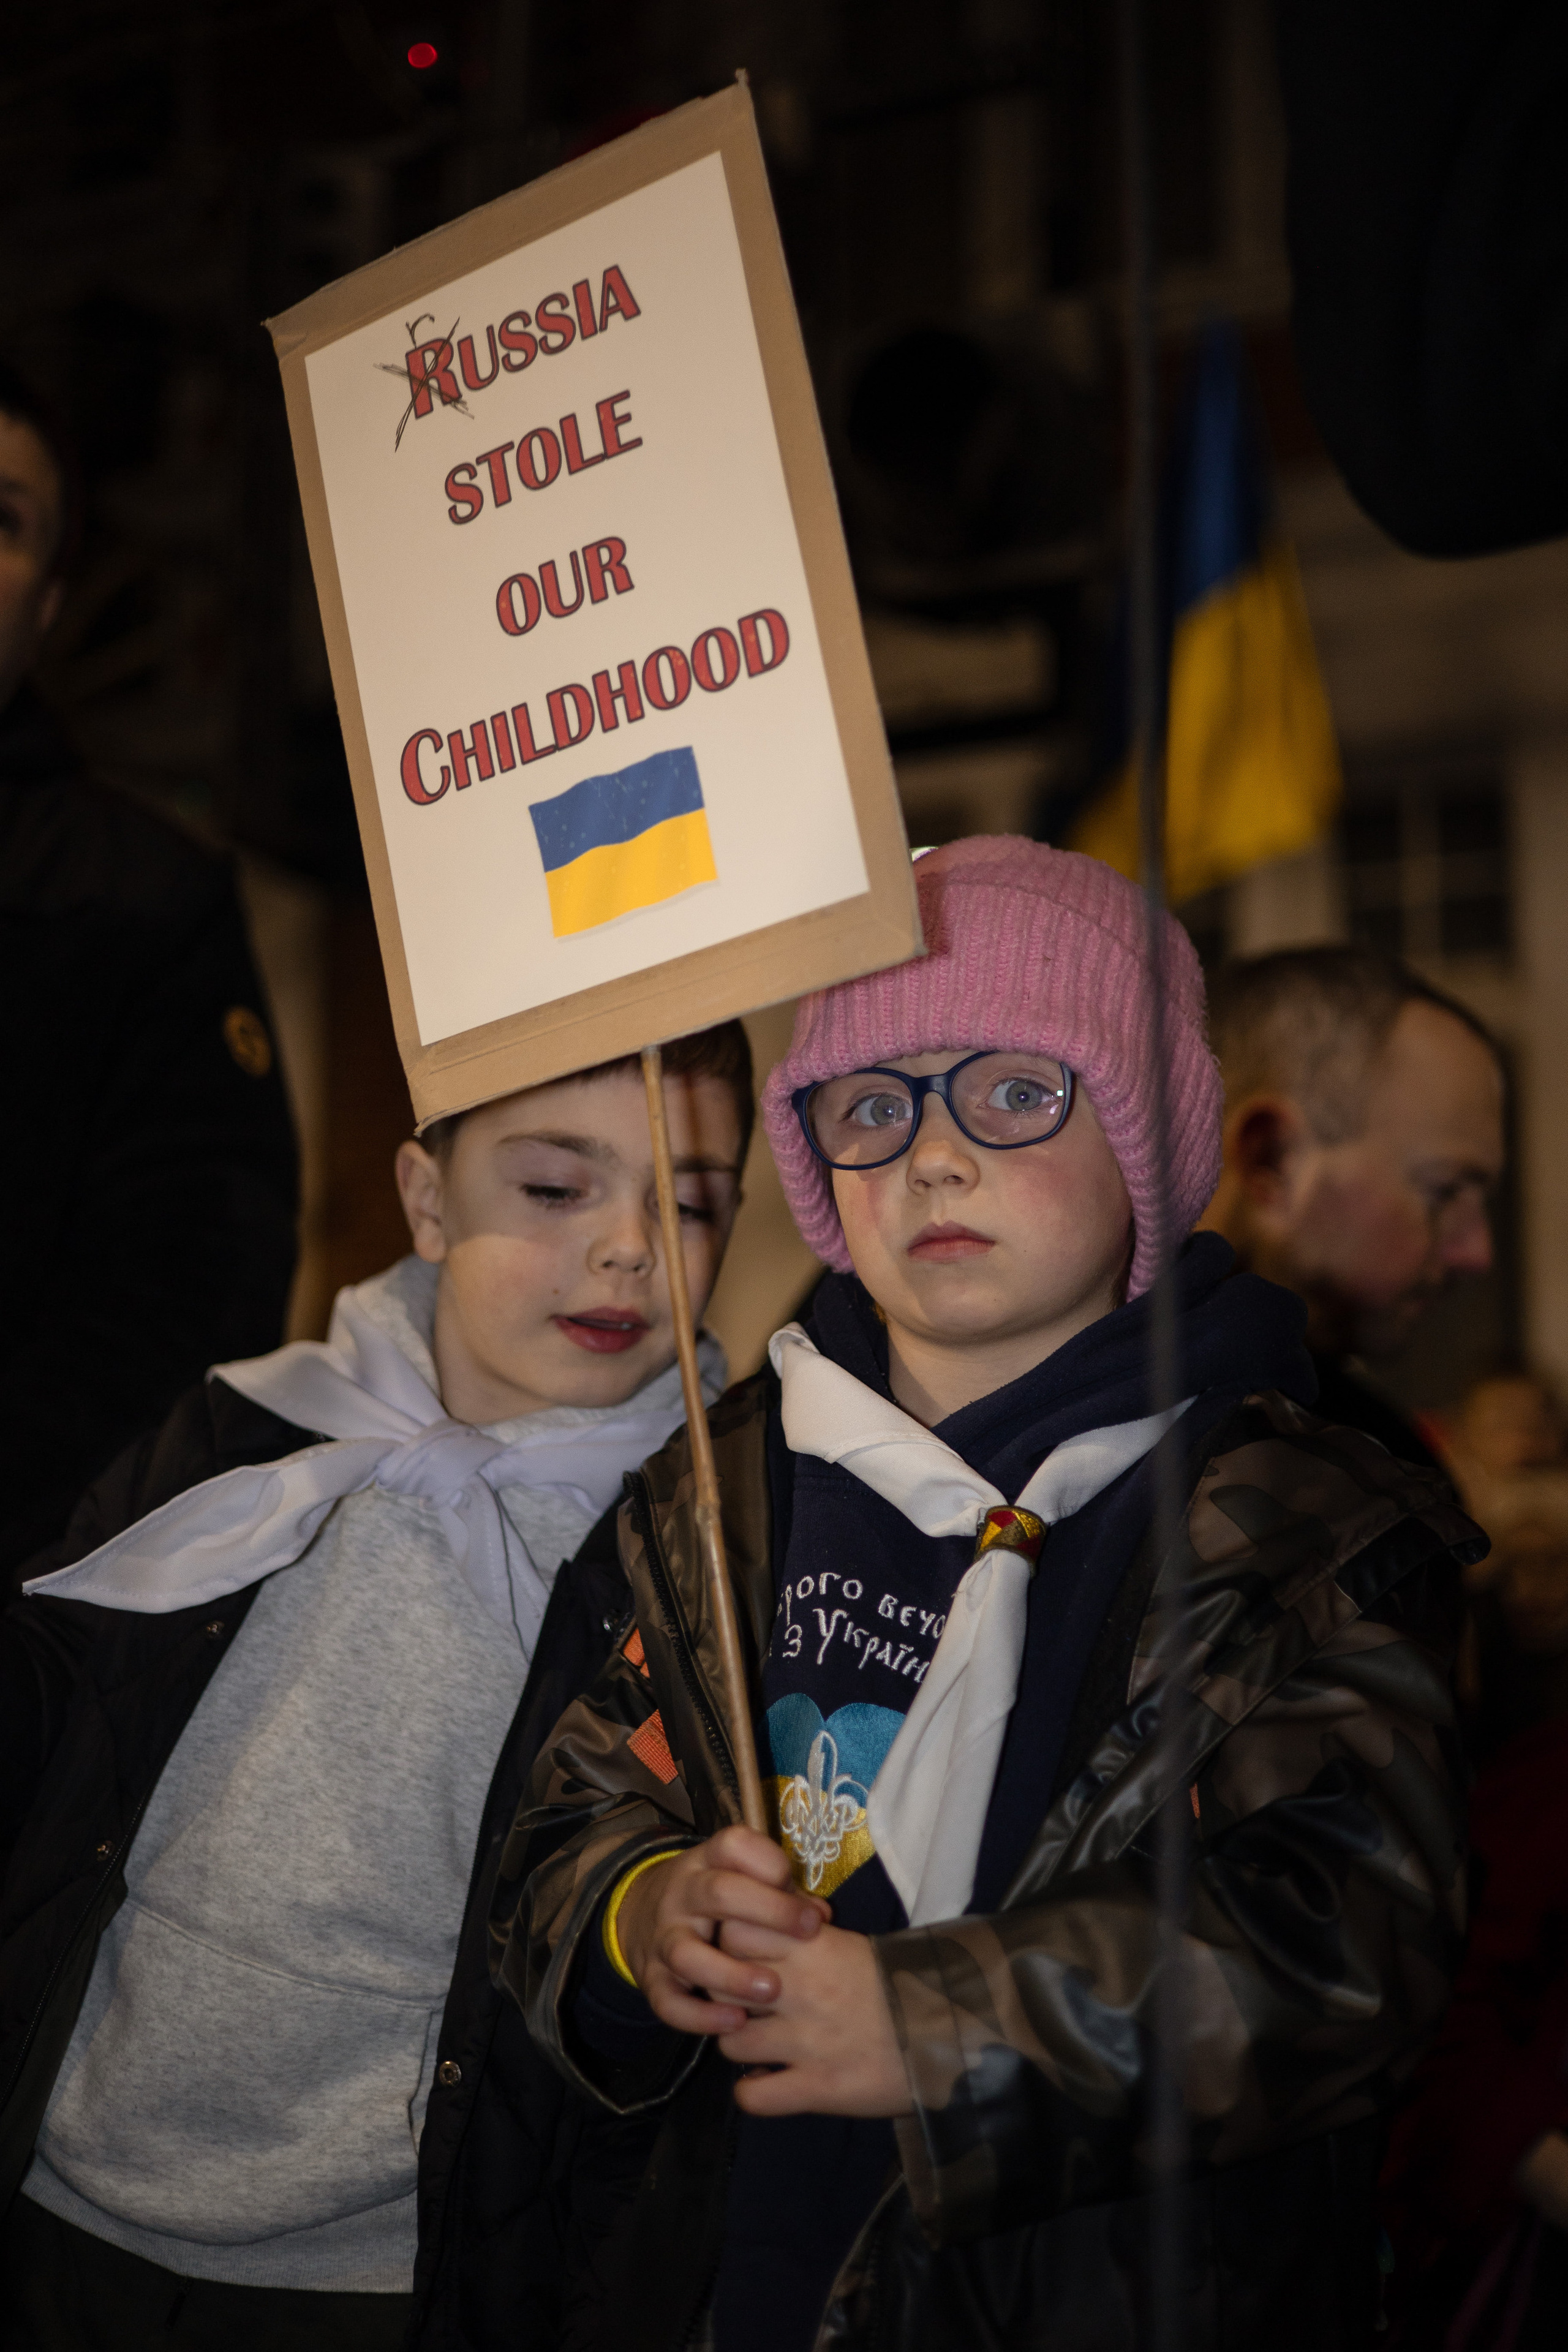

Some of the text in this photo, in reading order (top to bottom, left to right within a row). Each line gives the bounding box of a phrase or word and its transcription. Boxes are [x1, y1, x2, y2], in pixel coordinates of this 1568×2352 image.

[405, 264, 641, 420] RUSSIA
[443, 390, 643, 525] STOLE
[496, 536, 635, 636] OUR
[400, 608, 790, 805] CHILDHOOD
[777, 1572, 864, 1627] рого
